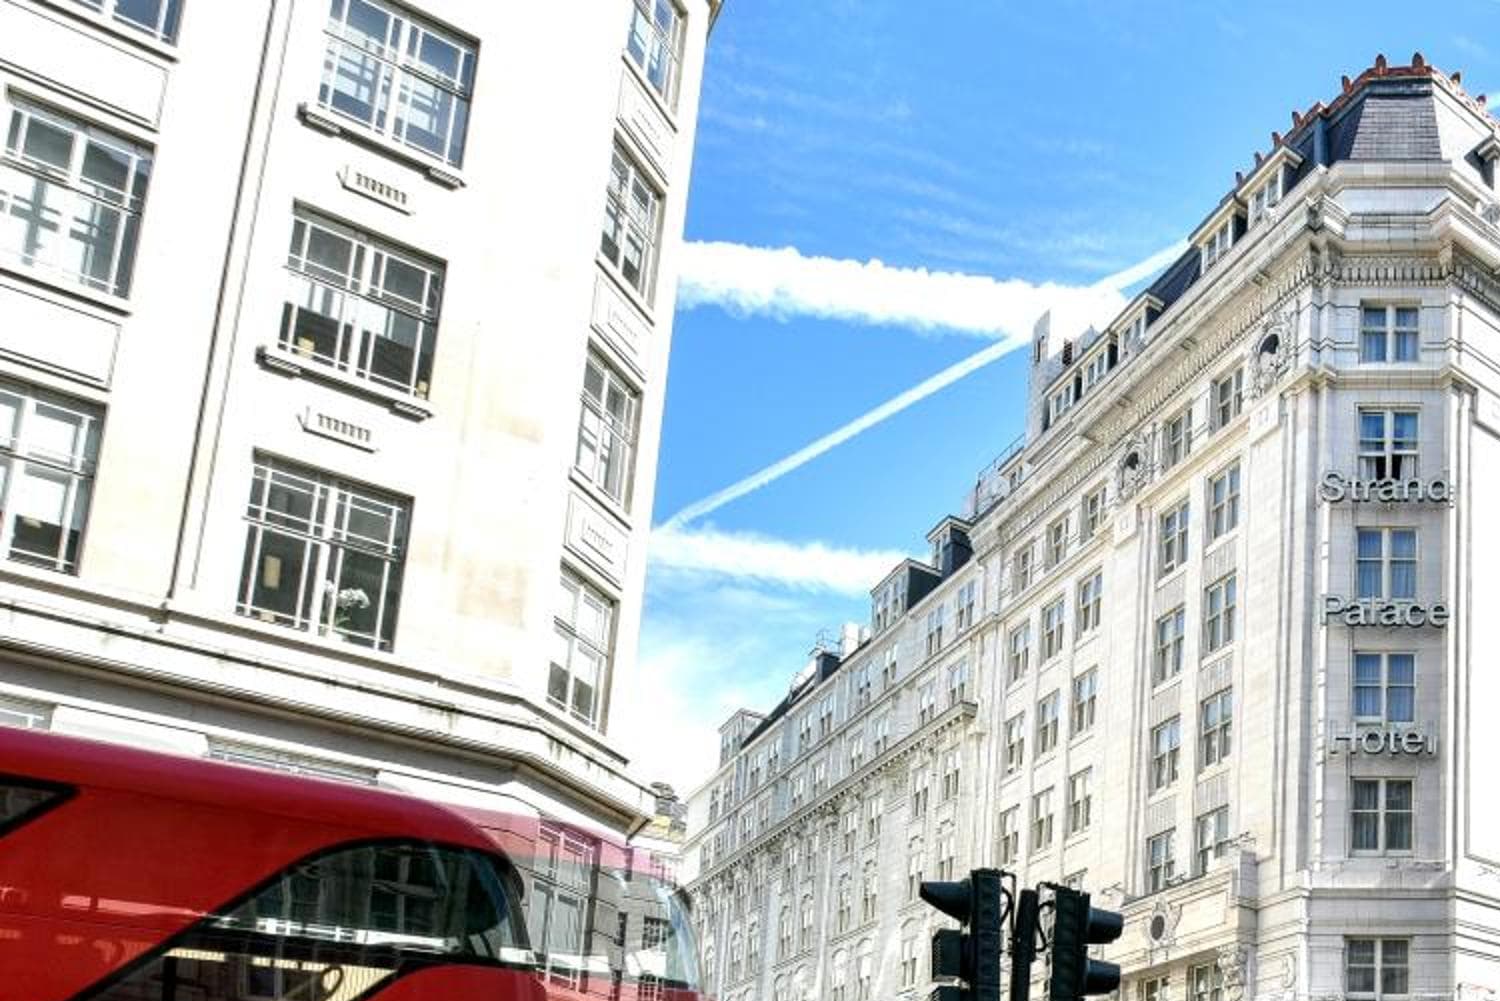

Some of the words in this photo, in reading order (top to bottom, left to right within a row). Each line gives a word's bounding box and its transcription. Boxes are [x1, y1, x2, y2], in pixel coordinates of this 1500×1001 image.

[1321, 471, 1450, 502] Strand
[1319, 594, 1450, 628] Palace
[1327, 719, 1438, 755] Hotel
